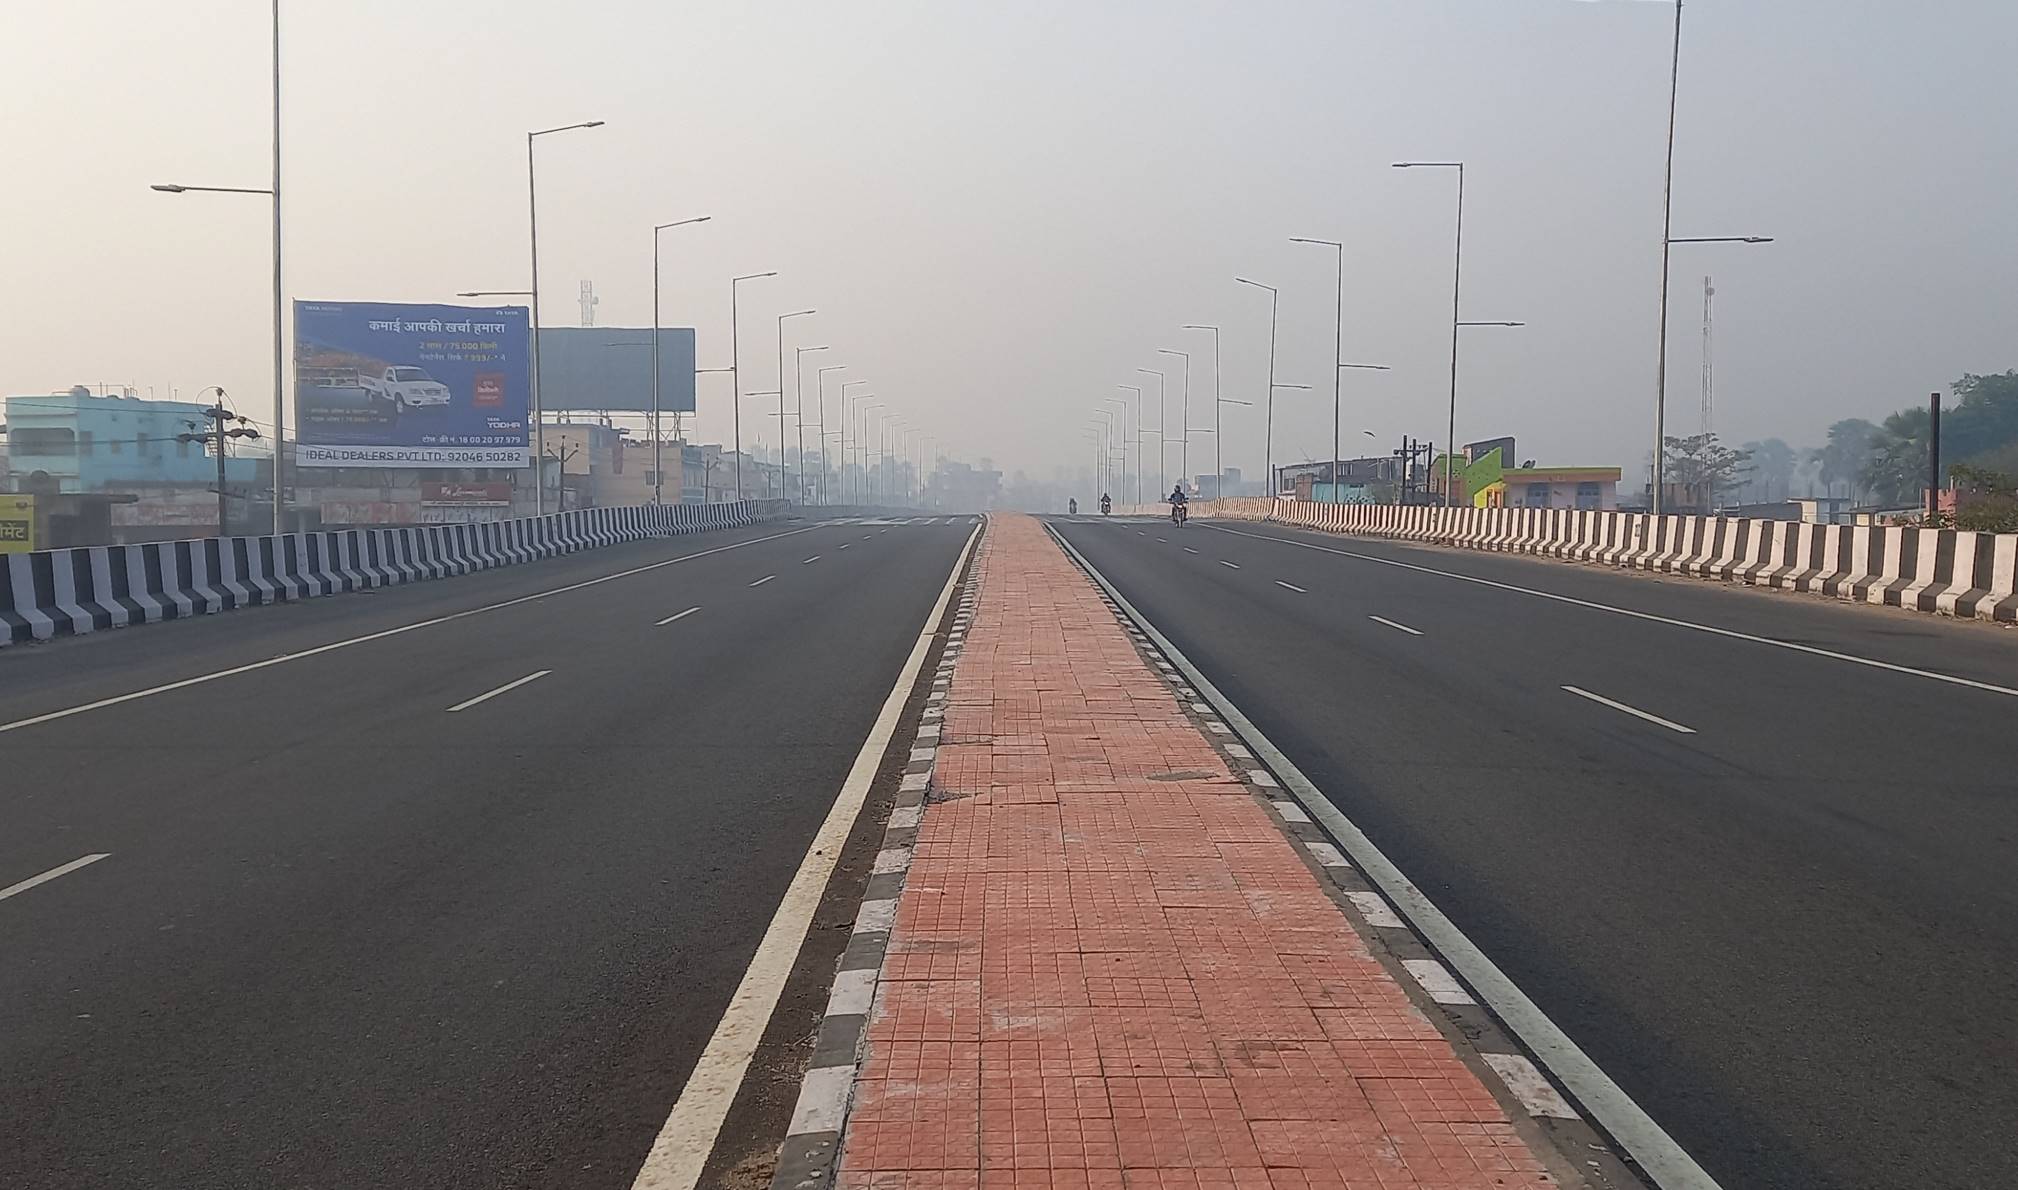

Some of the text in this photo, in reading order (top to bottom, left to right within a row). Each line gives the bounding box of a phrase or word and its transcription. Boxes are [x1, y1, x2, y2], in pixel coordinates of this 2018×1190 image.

[369, 318, 505, 335] कमाई आपकी खर्चा हमारा
[306, 450, 339, 460] IDEAL
[342, 450, 394, 461] DEALERS
[447, 452, 483, 462] 92046
[486, 452, 521, 462] 50282
